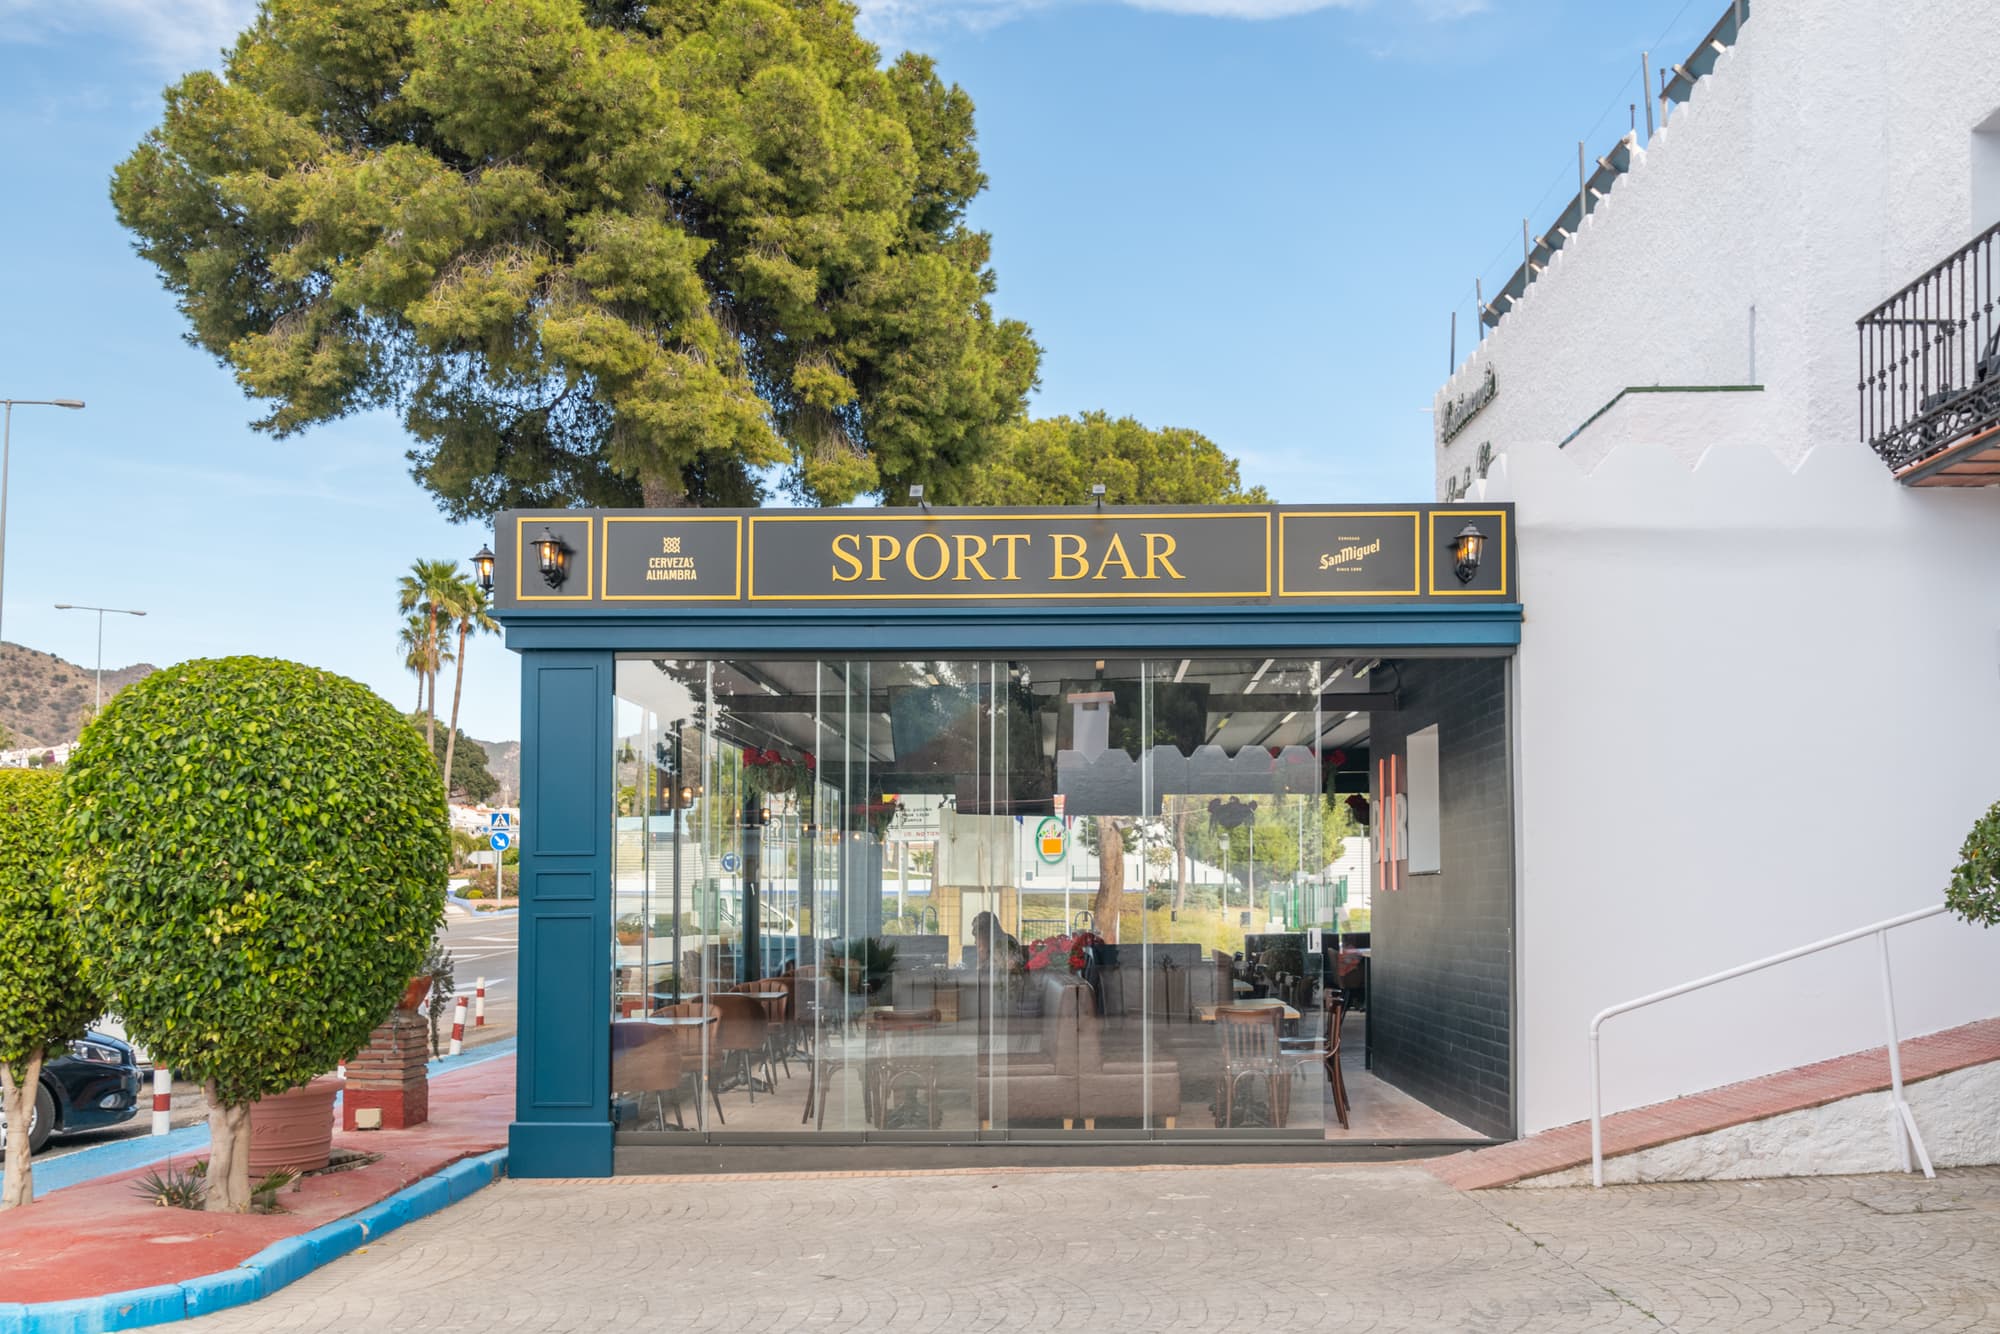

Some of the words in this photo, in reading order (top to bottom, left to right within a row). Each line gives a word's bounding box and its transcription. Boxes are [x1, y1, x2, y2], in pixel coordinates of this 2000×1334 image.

[649, 557, 695, 569] CERVEZAS
[831, 532, 1031, 582] SPORT
[1050, 532, 1186, 582] BAR
[646, 569, 697, 581] ALHAMBRA
